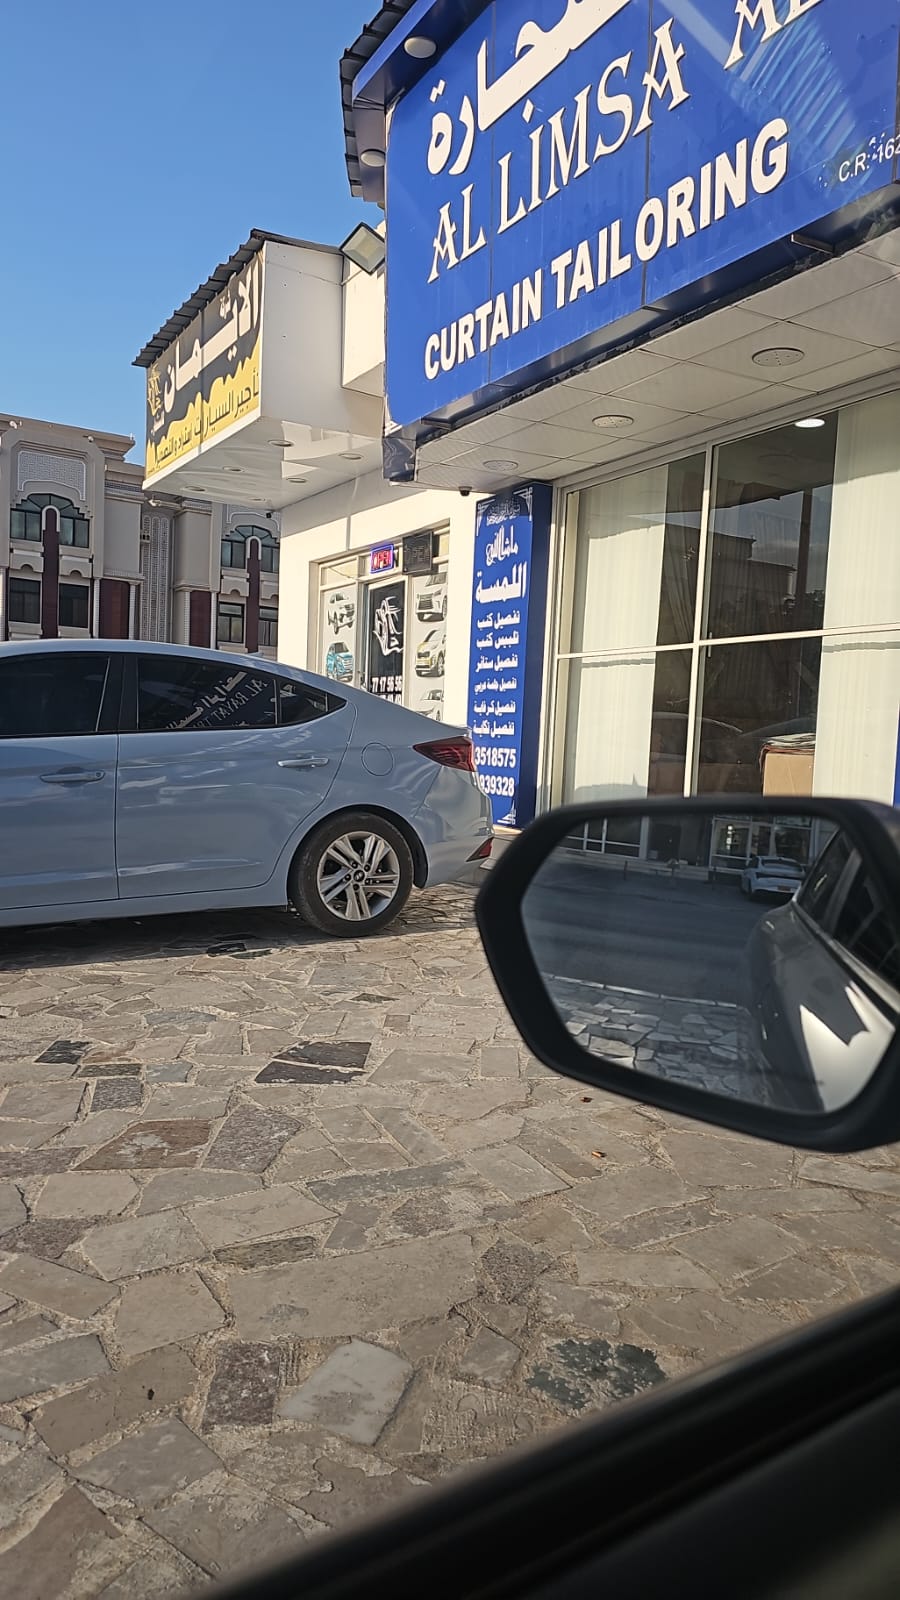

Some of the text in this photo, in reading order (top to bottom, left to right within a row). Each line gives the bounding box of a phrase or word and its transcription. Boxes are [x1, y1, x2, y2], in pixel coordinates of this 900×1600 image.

[427, 183, 487, 283] AL
[424, 118, 788, 379] CURTAIN TAILORING
[475, 560, 527, 604] اللمسة
[477, 609, 520, 630] تفصيل كنب
[476, 632, 494, 650] كنب
[494, 653, 519, 671] تفصيل
[498, 677, 517, 693] تفصيل
[495, 701, 516, 716] تفصيل
[491, 720, 515, 737] تفصيل
[475, 747, 516, 769] 3518575
